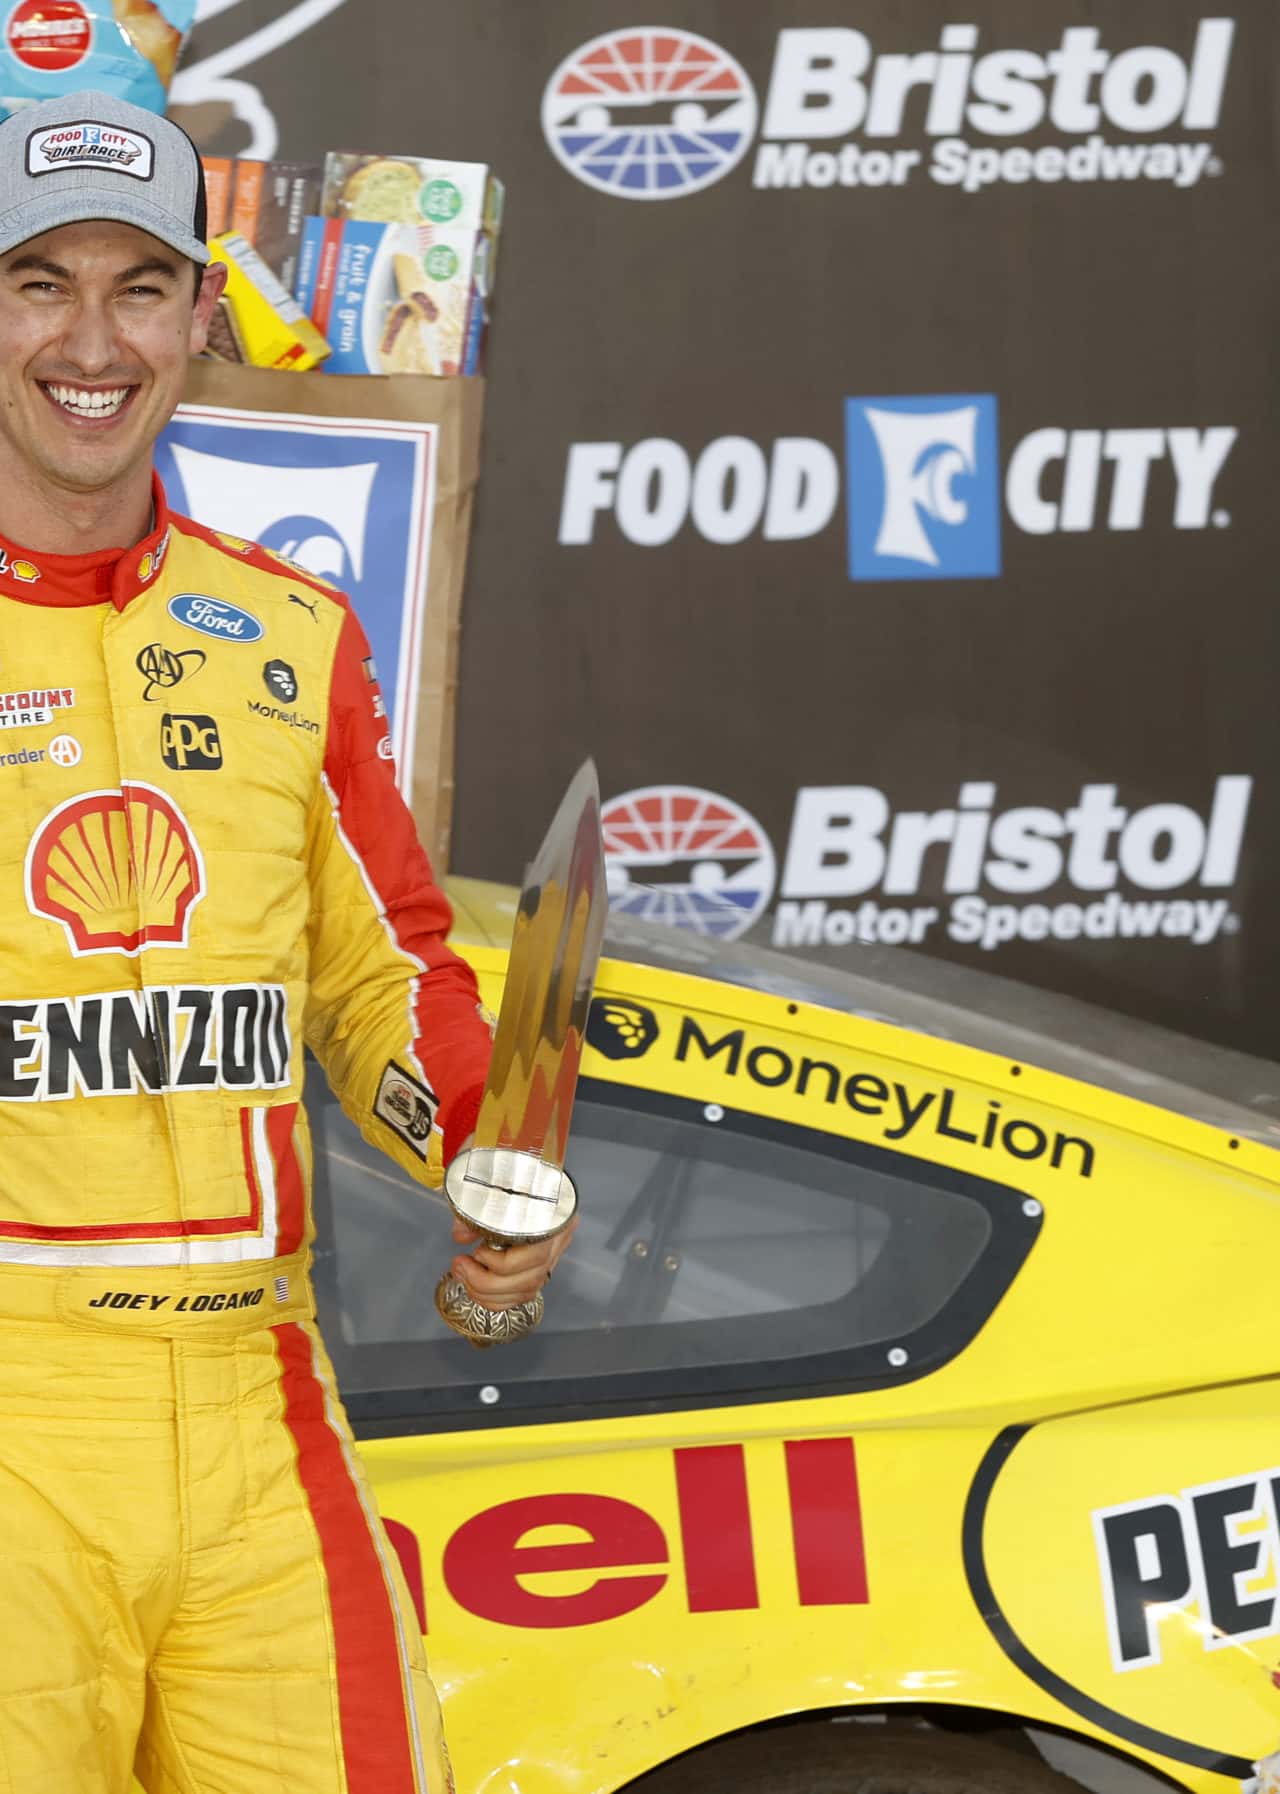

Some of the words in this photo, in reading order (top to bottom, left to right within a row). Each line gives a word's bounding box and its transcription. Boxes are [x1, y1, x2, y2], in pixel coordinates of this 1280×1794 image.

[762, 18, 1234, 139] Bristol
[50, 131, 81, 144] FOOD
[101, 133, 127, 145] CITY
[53, 145, 87, 158] DIRT
[88, 145, 129, 160] RACE
[753, 144, 919, 189] Motor
[930, 136, 1213, 192] Speedway
[352, 244, 371, 283] fruit
[347, 291, 362, 303] &
[338, 309, 358, 353] grain
[558, 436, 839, 546] FOOD
[1007, 427, 1237, 534] CITY
[186, 599, 245, 635] Ford
[0, 712, 46, 727] TIRE
[162, 719, 220, 767] PPG
[781, 776, 1253, 897] Bristol
[773, 902, 935, 947] Motor
[949, 893, 1229, 949] Speedway
[675, 1015, 1096, 1177] MoneyLion
[89, 1290, 170, 1311] JOEY
[174, 1287, 265, 1312] LOGANO
